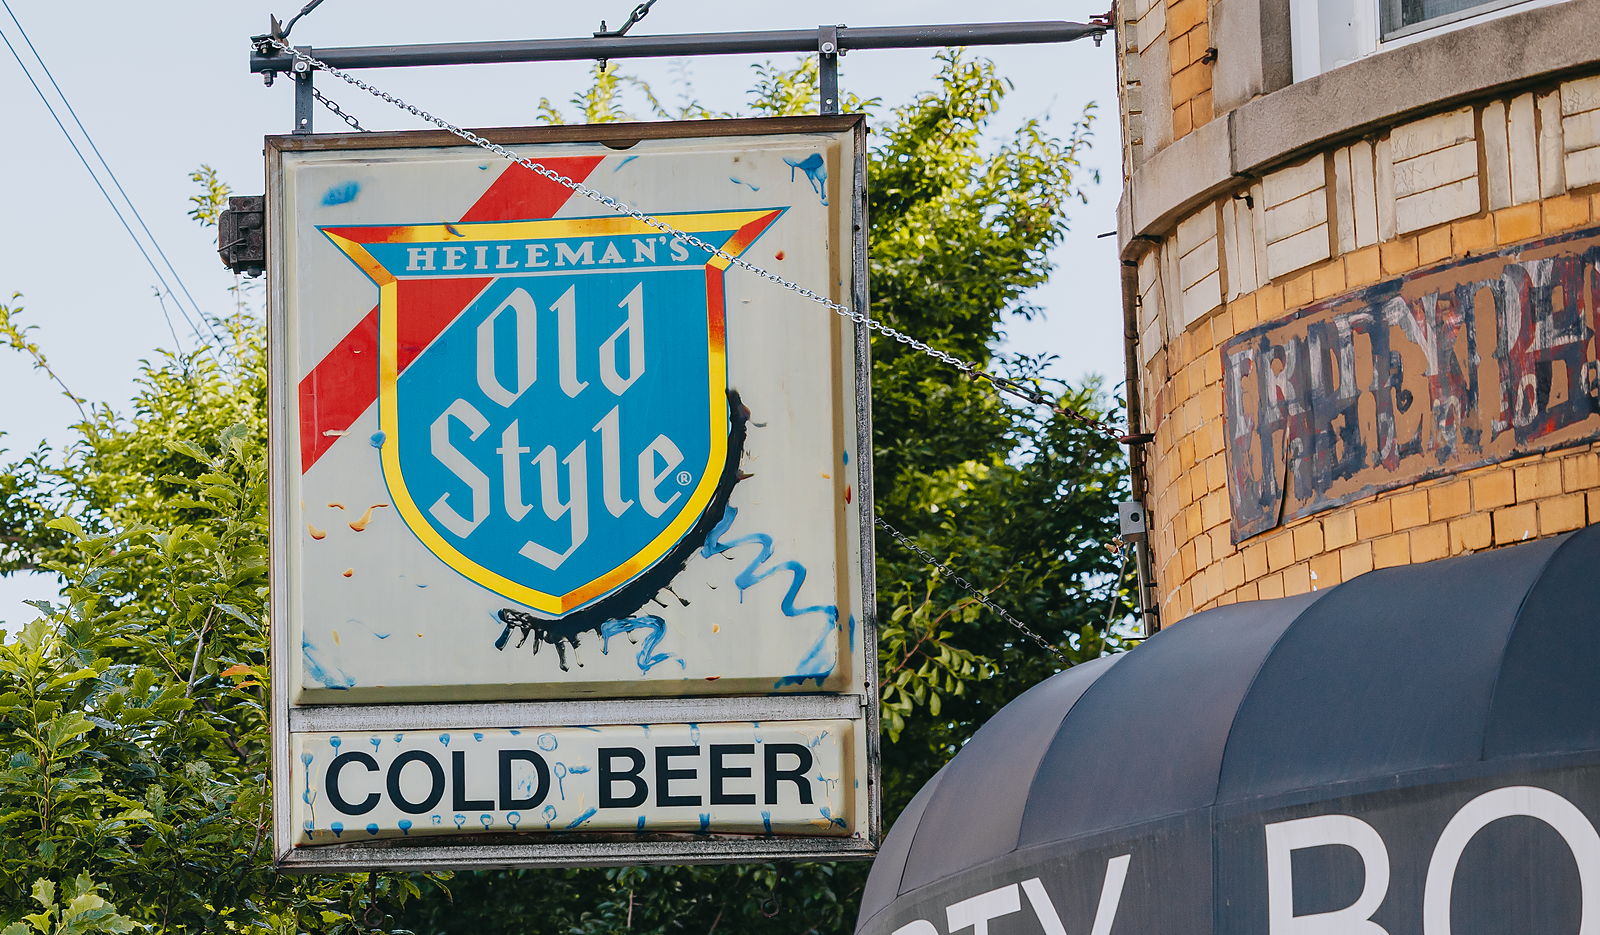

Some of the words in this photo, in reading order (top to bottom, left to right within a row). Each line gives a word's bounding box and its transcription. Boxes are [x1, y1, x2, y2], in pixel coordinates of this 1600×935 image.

[405, 236, 690, 271] HEILEMAN'S
[477, 281, 646, 409] Old
[325, 748, 551, 815] COLD
[598, 743, 814, 808] BEER
